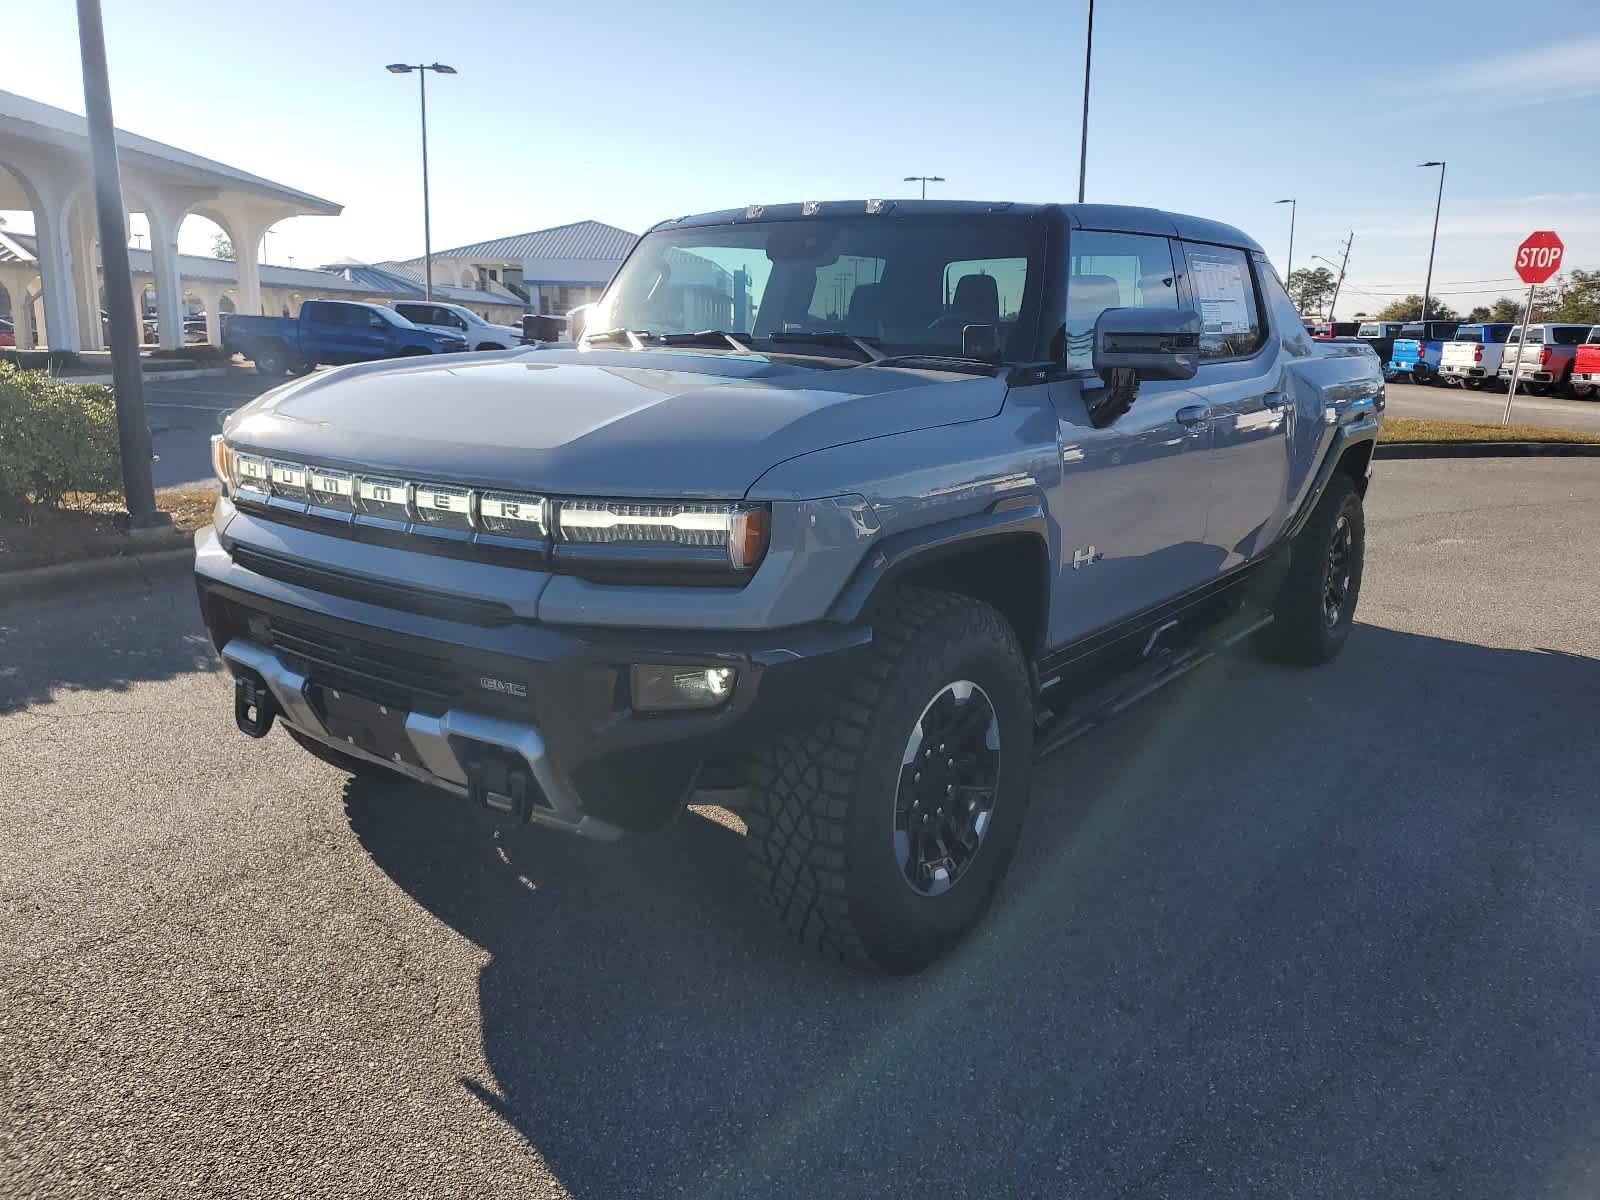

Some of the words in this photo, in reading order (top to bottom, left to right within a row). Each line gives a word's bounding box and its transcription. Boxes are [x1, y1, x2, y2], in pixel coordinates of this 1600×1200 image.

[1517, 247, 1561, 268] STOP
[246, 462, 522, 519] HUMMER
[479, 677, 527, 697] GMC
